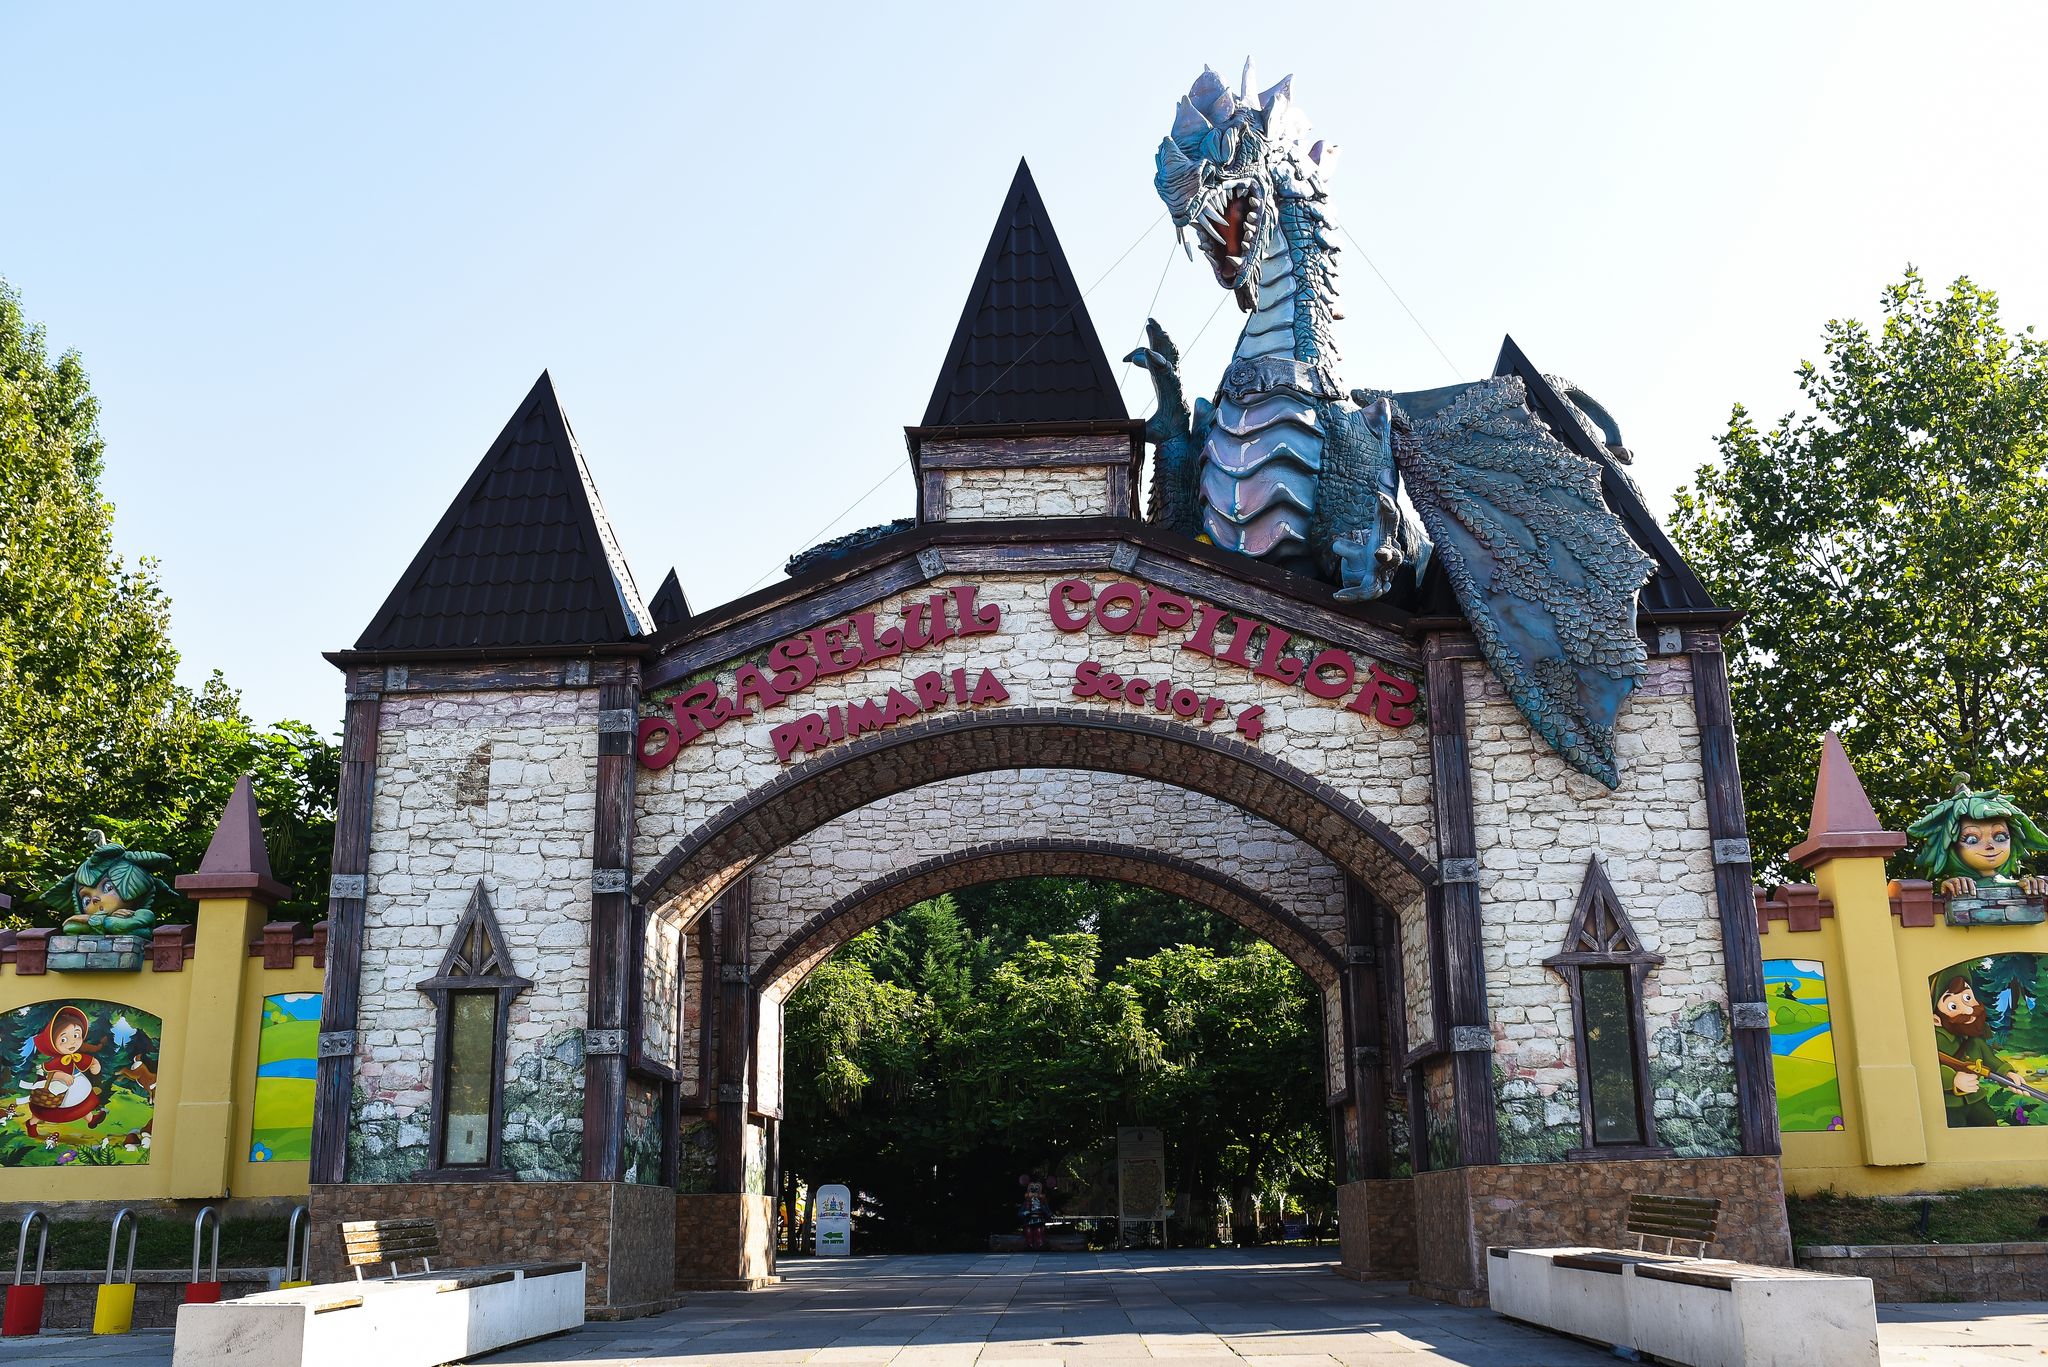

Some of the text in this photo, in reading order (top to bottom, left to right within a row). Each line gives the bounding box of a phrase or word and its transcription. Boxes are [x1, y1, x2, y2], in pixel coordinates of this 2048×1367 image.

[637, 579, 1418, 770] ORASELUL COPIILOR
[769, 661, 1264, 763] PRIMARIA Sector 4
